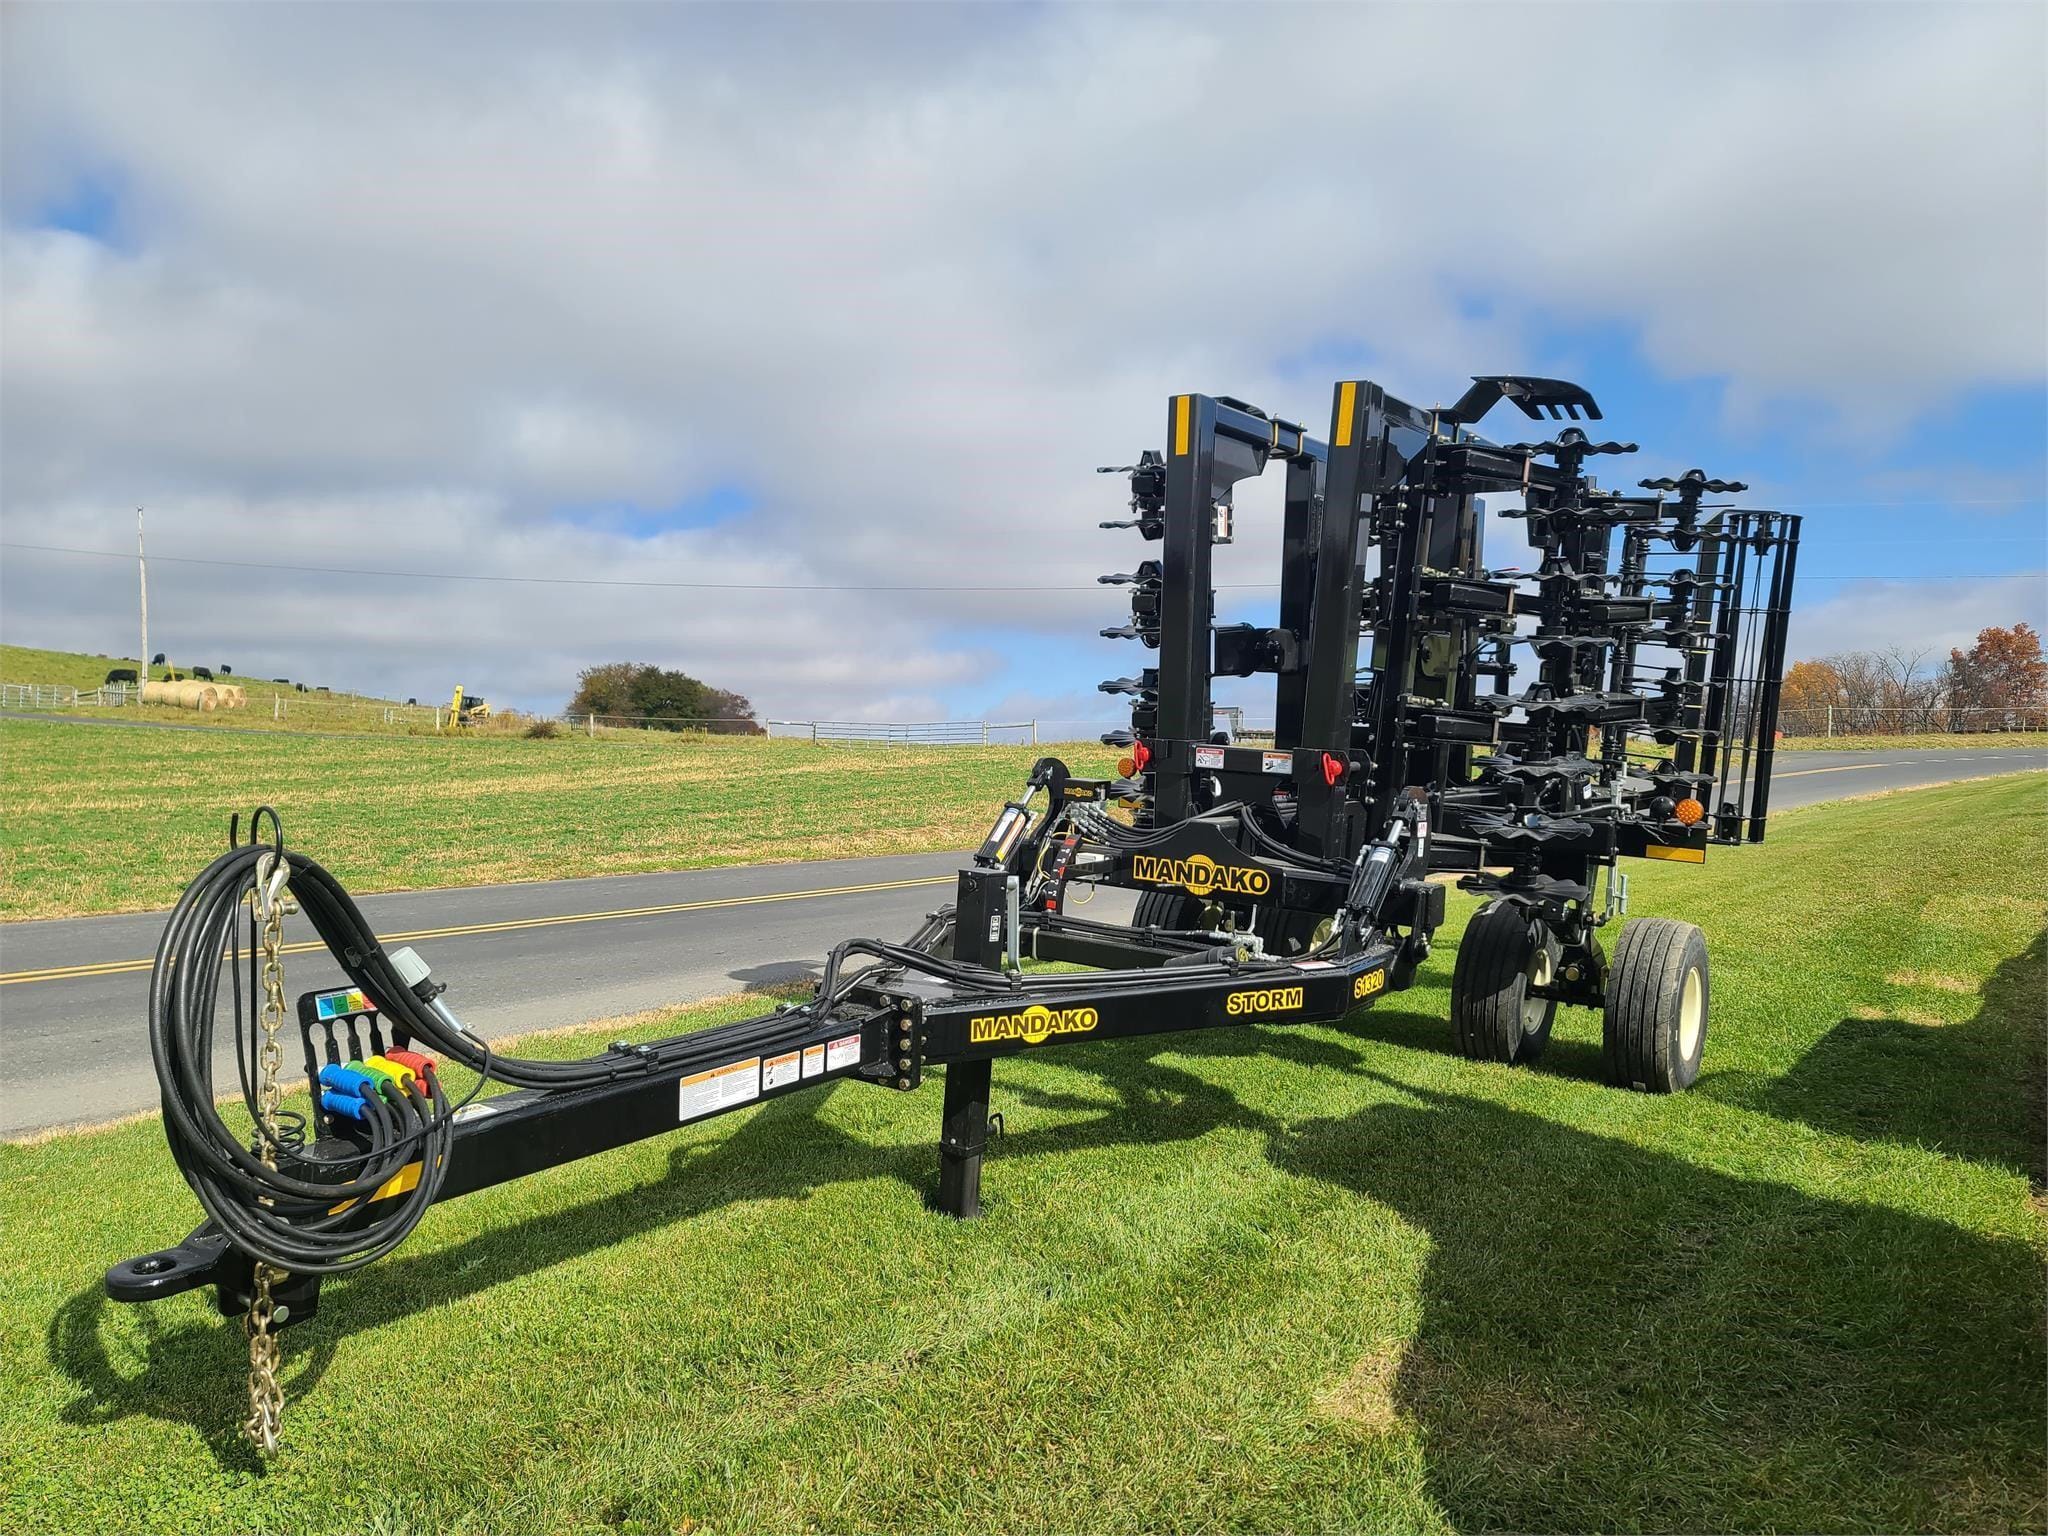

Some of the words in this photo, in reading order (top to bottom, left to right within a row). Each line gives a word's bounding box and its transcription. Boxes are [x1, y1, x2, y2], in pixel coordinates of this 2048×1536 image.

[1133, 855, 1270, 895] MANDAKO
[1354, 968, 1384, 999] S1320
[1226, 987, 1304, 1015] STORM
[971, 1007, 1098, 1043] MANDAKO
